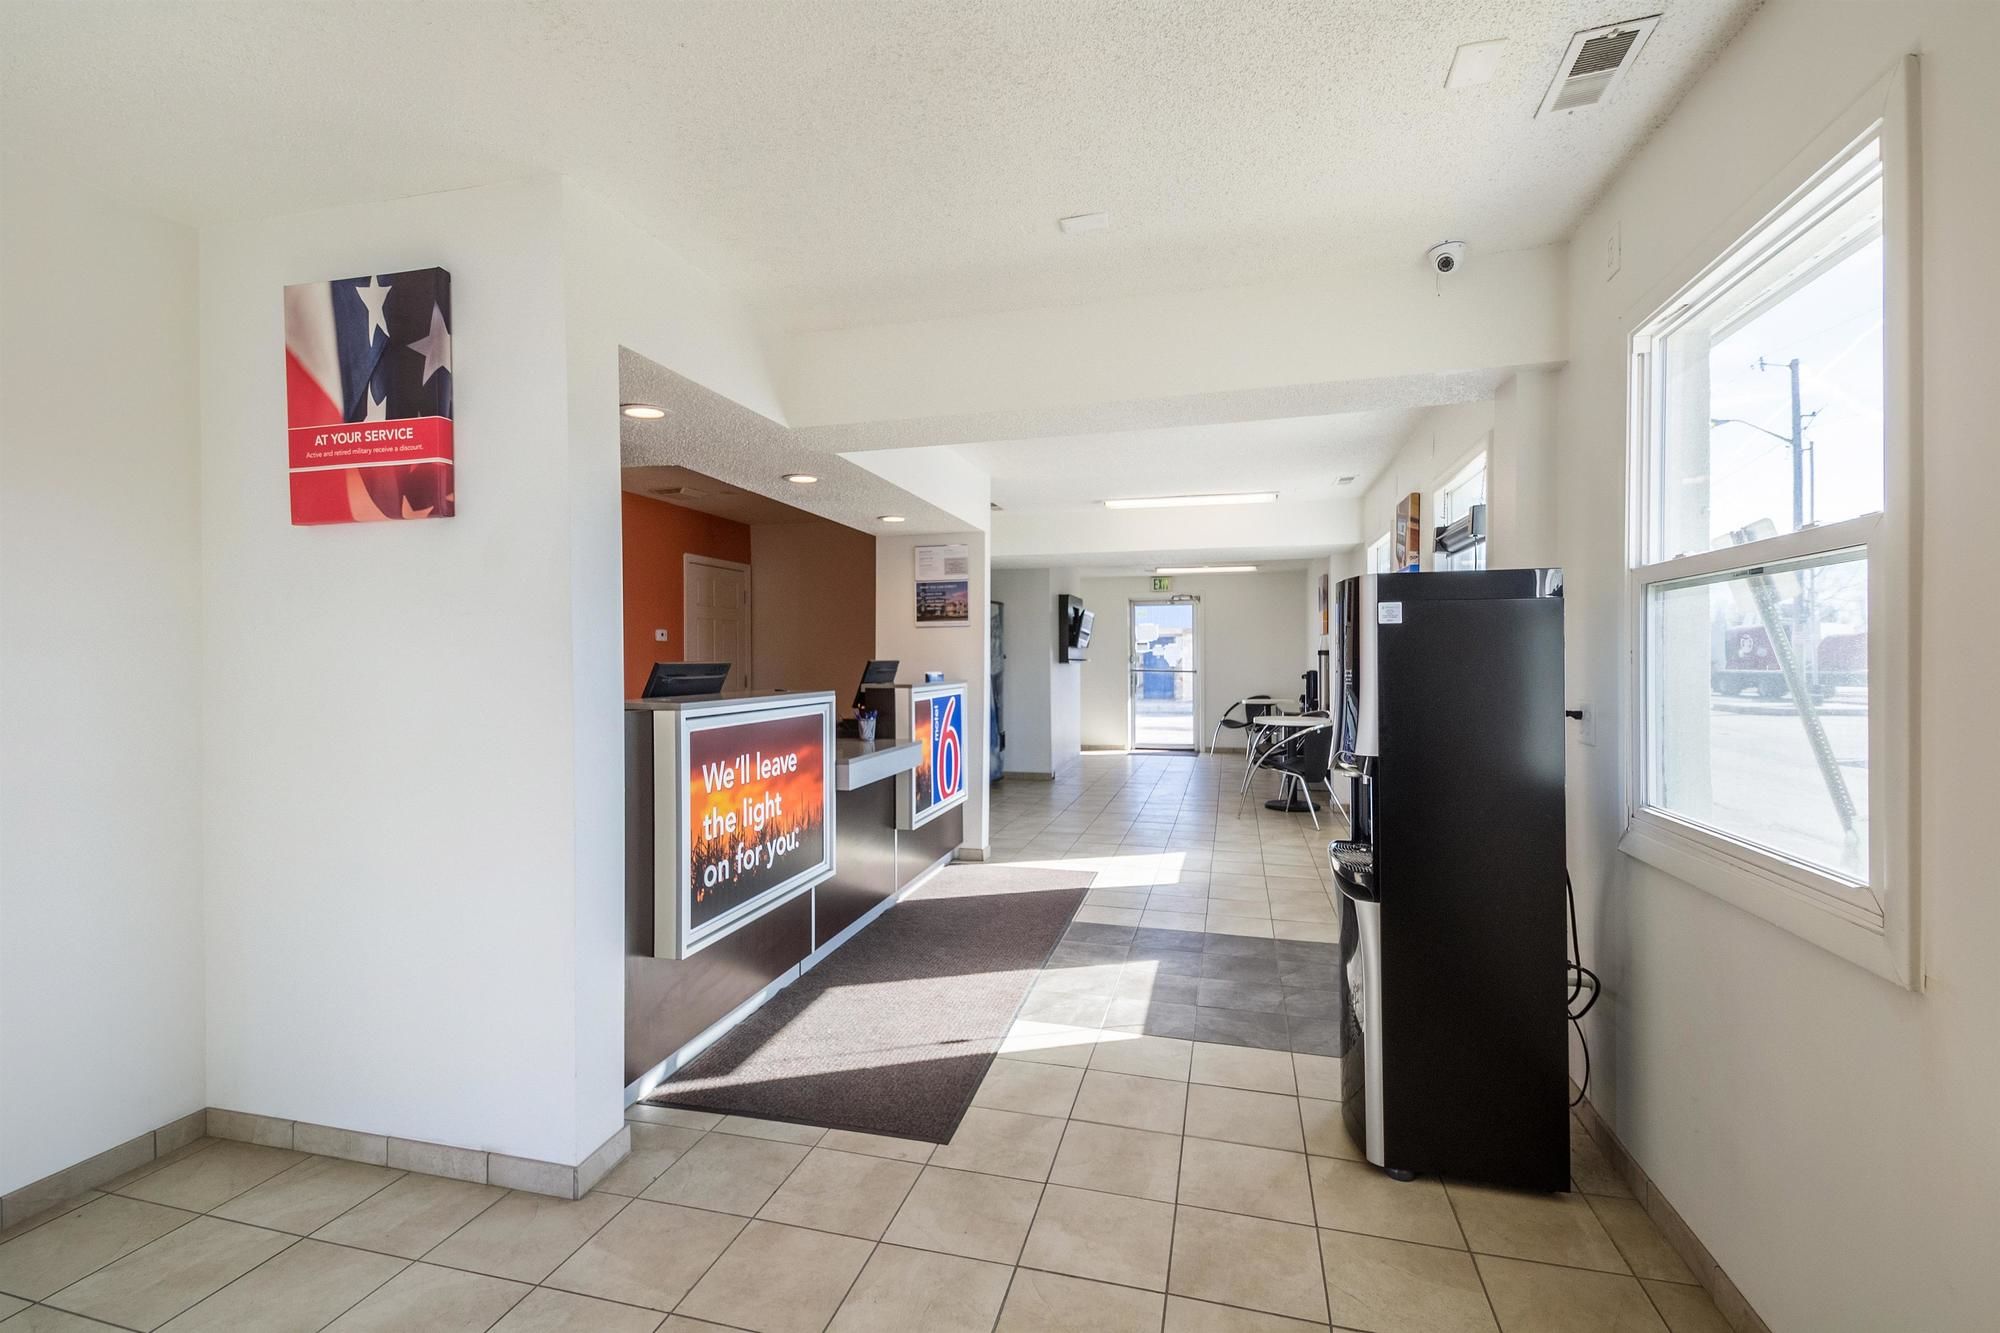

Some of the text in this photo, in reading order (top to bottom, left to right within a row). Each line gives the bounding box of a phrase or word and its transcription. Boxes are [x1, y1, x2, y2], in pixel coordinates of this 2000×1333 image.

[306, 451, 322, 459] Active
[334, 448, 352, 457] retired
[352, 446, 372, 456] military
[373, 445, 394, 453] receive
[315, 427, 414, 446] AT YOUR SERVICE
[937, 696, 961, 801] 6
[702, 751, 798, 794] We'll leave
[703, 791, 782, 841] the light
[703, 858, 730, 887] on
[736, 841, 763, 874] for
